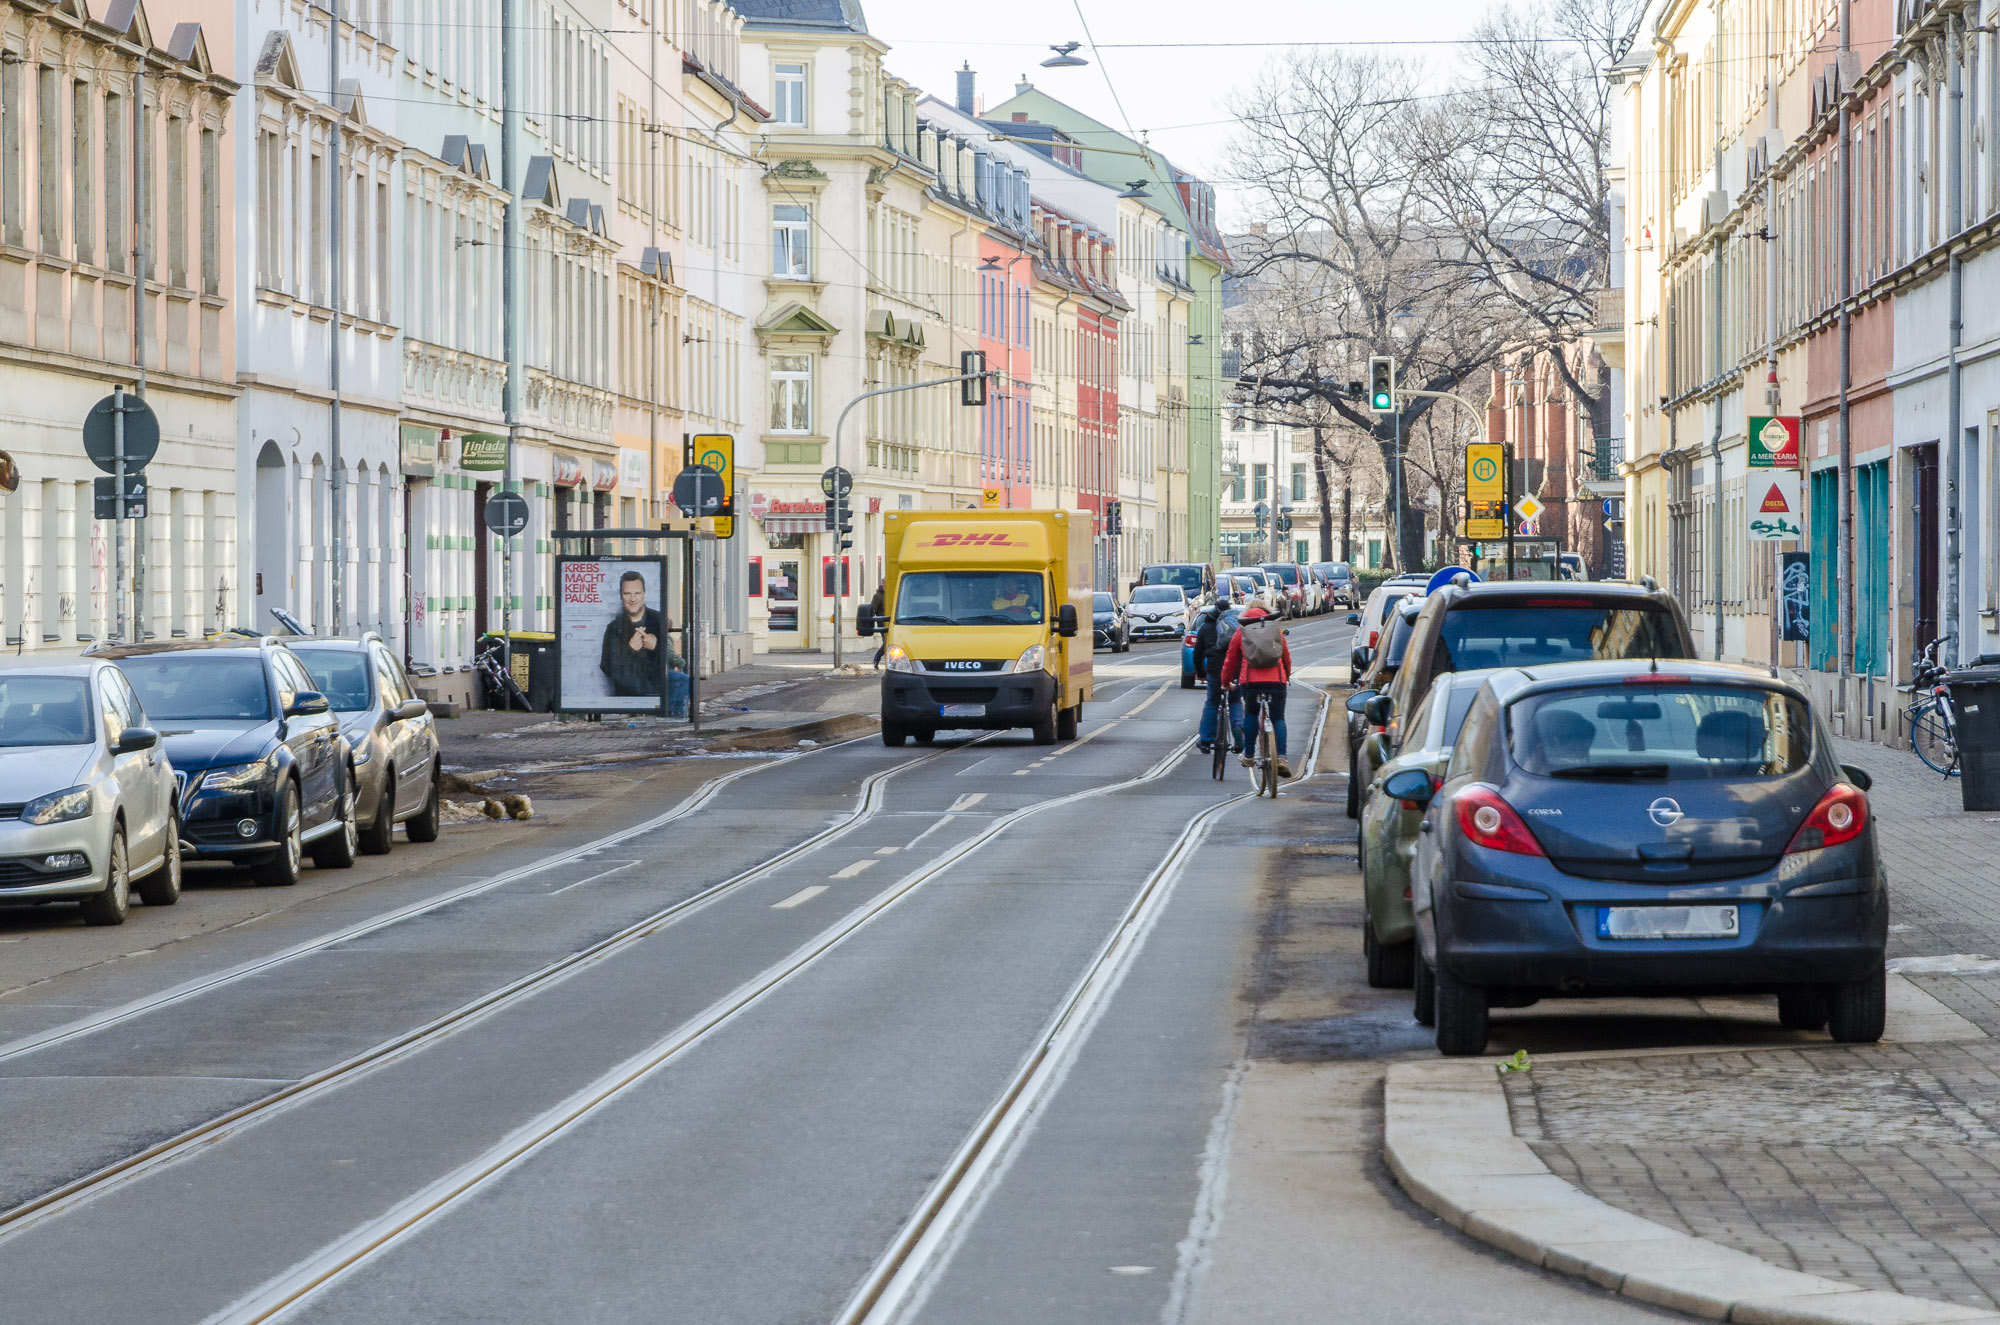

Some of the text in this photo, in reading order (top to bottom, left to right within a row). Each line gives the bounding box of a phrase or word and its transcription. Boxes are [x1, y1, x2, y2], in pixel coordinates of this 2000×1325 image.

[462, 440, 505, 457] Linlada
[1480, 462, 1490, 477] H
[770, 498, 827, 514] Bernhar
[931, 533, 1013, 547] DHL
[564, 563, 600, 573] KREBS
[564, 573, 606, 583] MACHT
[564, 583, 598, 593] KEINE
[564, 593, 603, 603] PAUSE.
[944, 661, 982, 669] IVECO
[1527, 808, 1563, 816] CORSA
